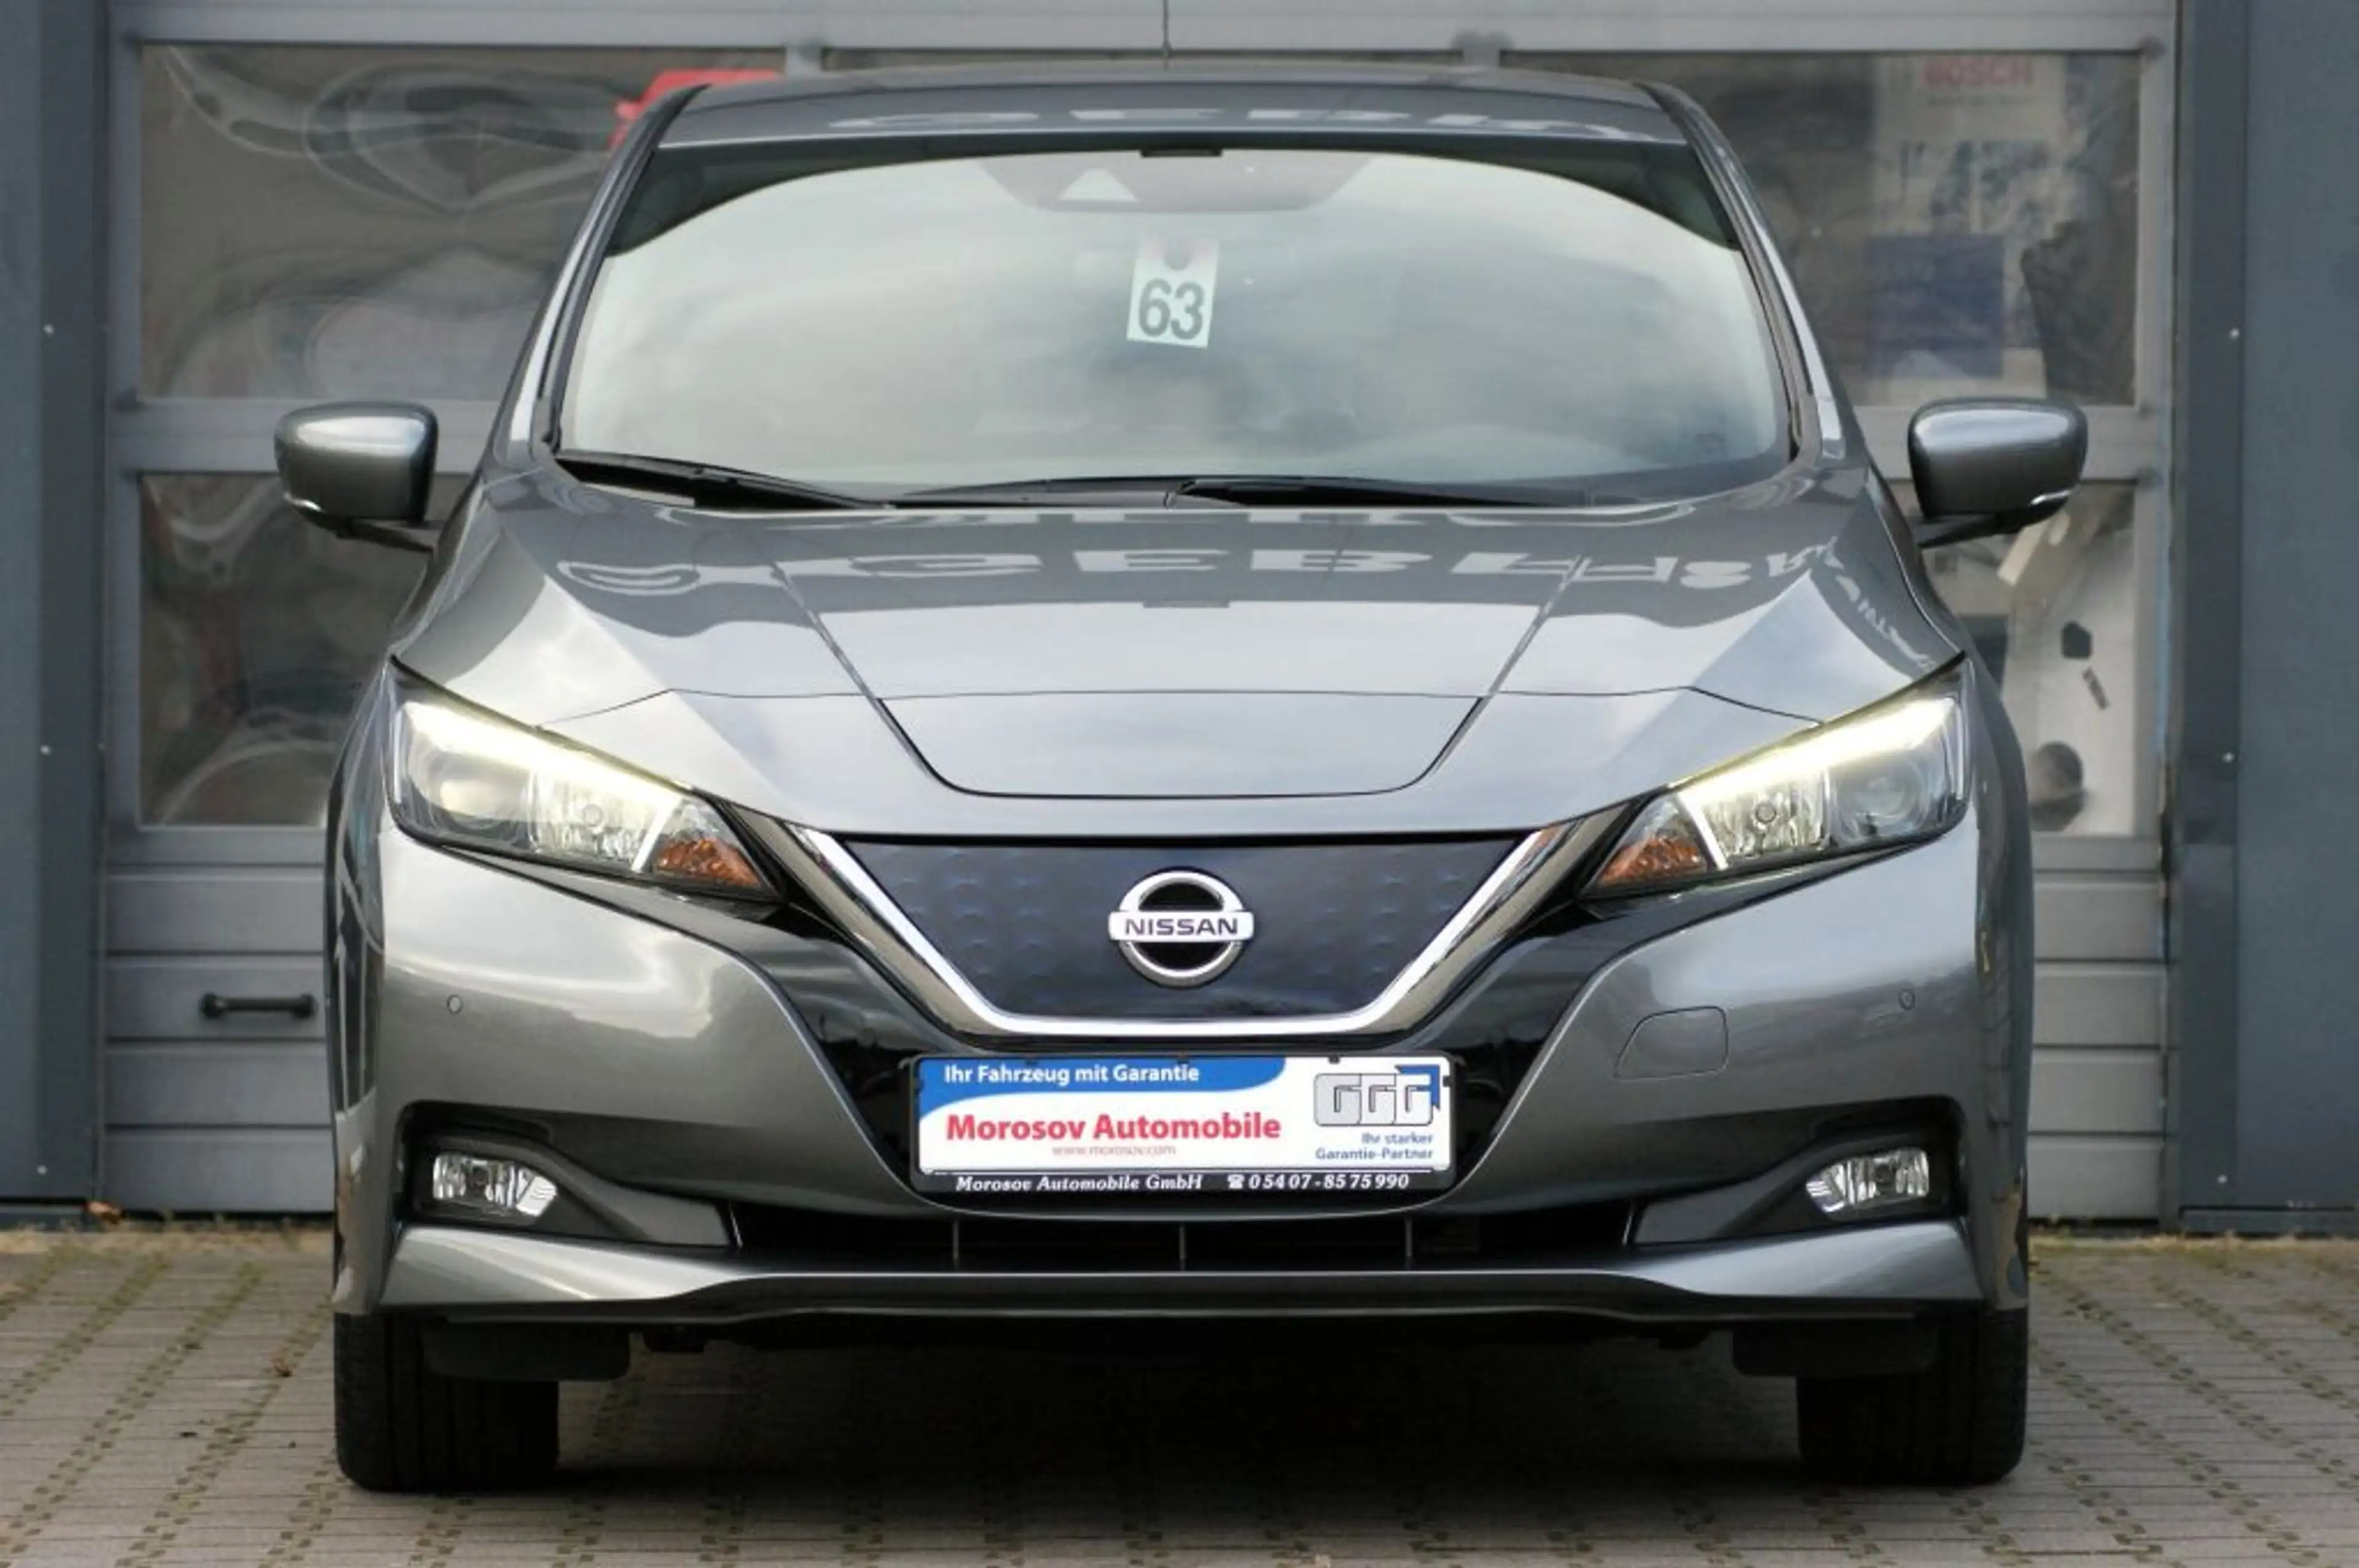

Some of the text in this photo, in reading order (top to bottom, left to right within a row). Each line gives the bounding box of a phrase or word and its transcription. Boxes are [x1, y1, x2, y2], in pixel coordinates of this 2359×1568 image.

[1138, 277, 1205, 340] 63
[1125, 918, 1238, 935] NISSAN
[944, 1064, 1200, 1086] Ihr Fahrzeug mit Garantie
[946, 1112, 1281, 1141] Morosov Automobile
[1361, 1131, 1434, 1144] Ihr starker
[1315, 1147, 1434, 1160] Garantie-Partner
[955, 1176, 1033, 1192] Morosov
[1036, 1175, 1140, 1192] Automobile
[1145, 1173, 1203, 1191] GmbH
